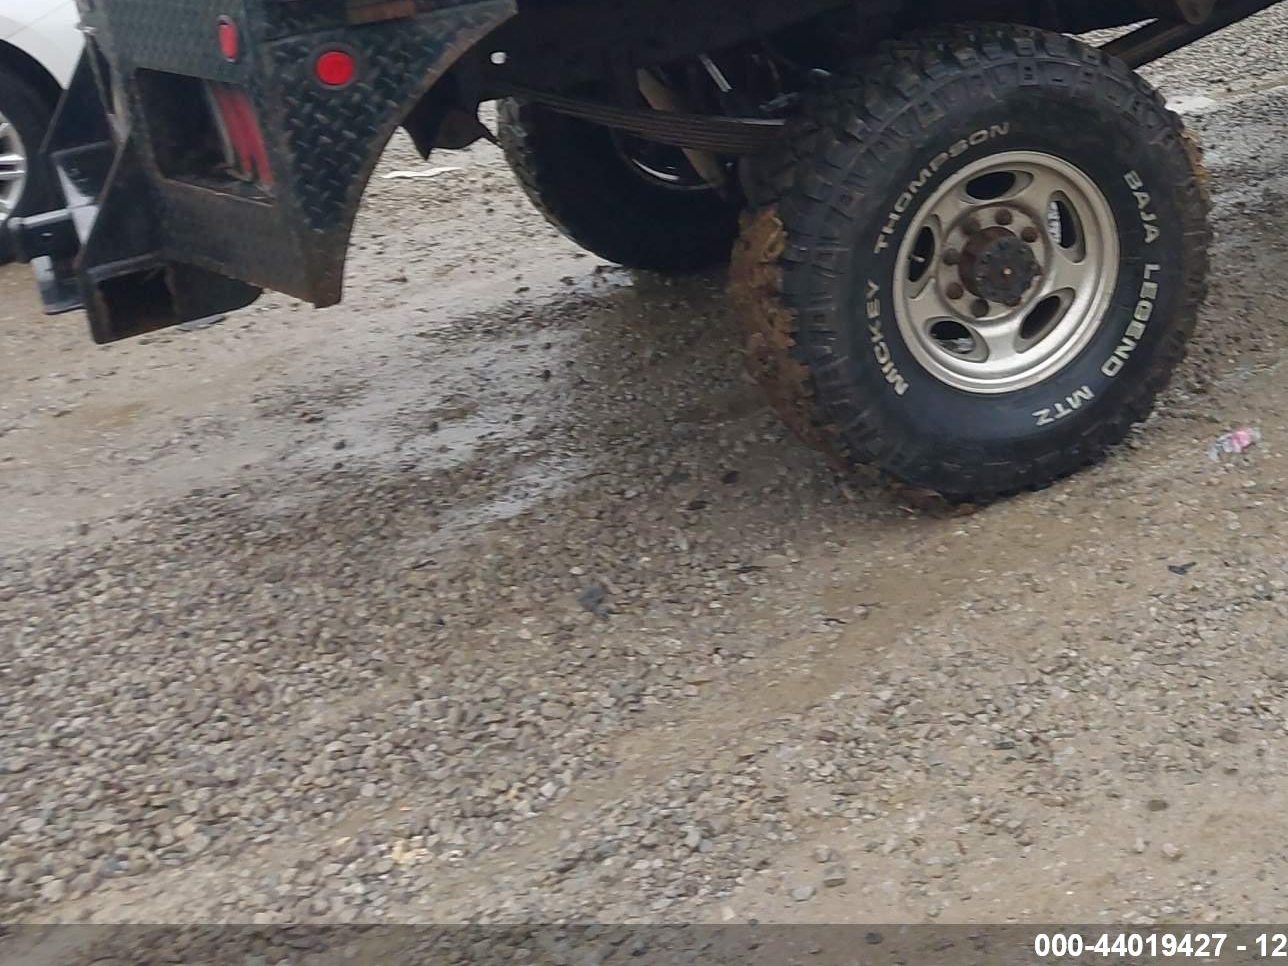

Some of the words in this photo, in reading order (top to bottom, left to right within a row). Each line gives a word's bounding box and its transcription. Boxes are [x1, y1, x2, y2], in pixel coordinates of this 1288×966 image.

[873, 121, 1010, 255] THOMPSON
[1123, 169, 1161, 244] BAJA
[866, 280, 909, 395] MICKEY
[1101, 263, 1161, 378] LEGEND
[1032, 385, 1096, 427] MTZ
